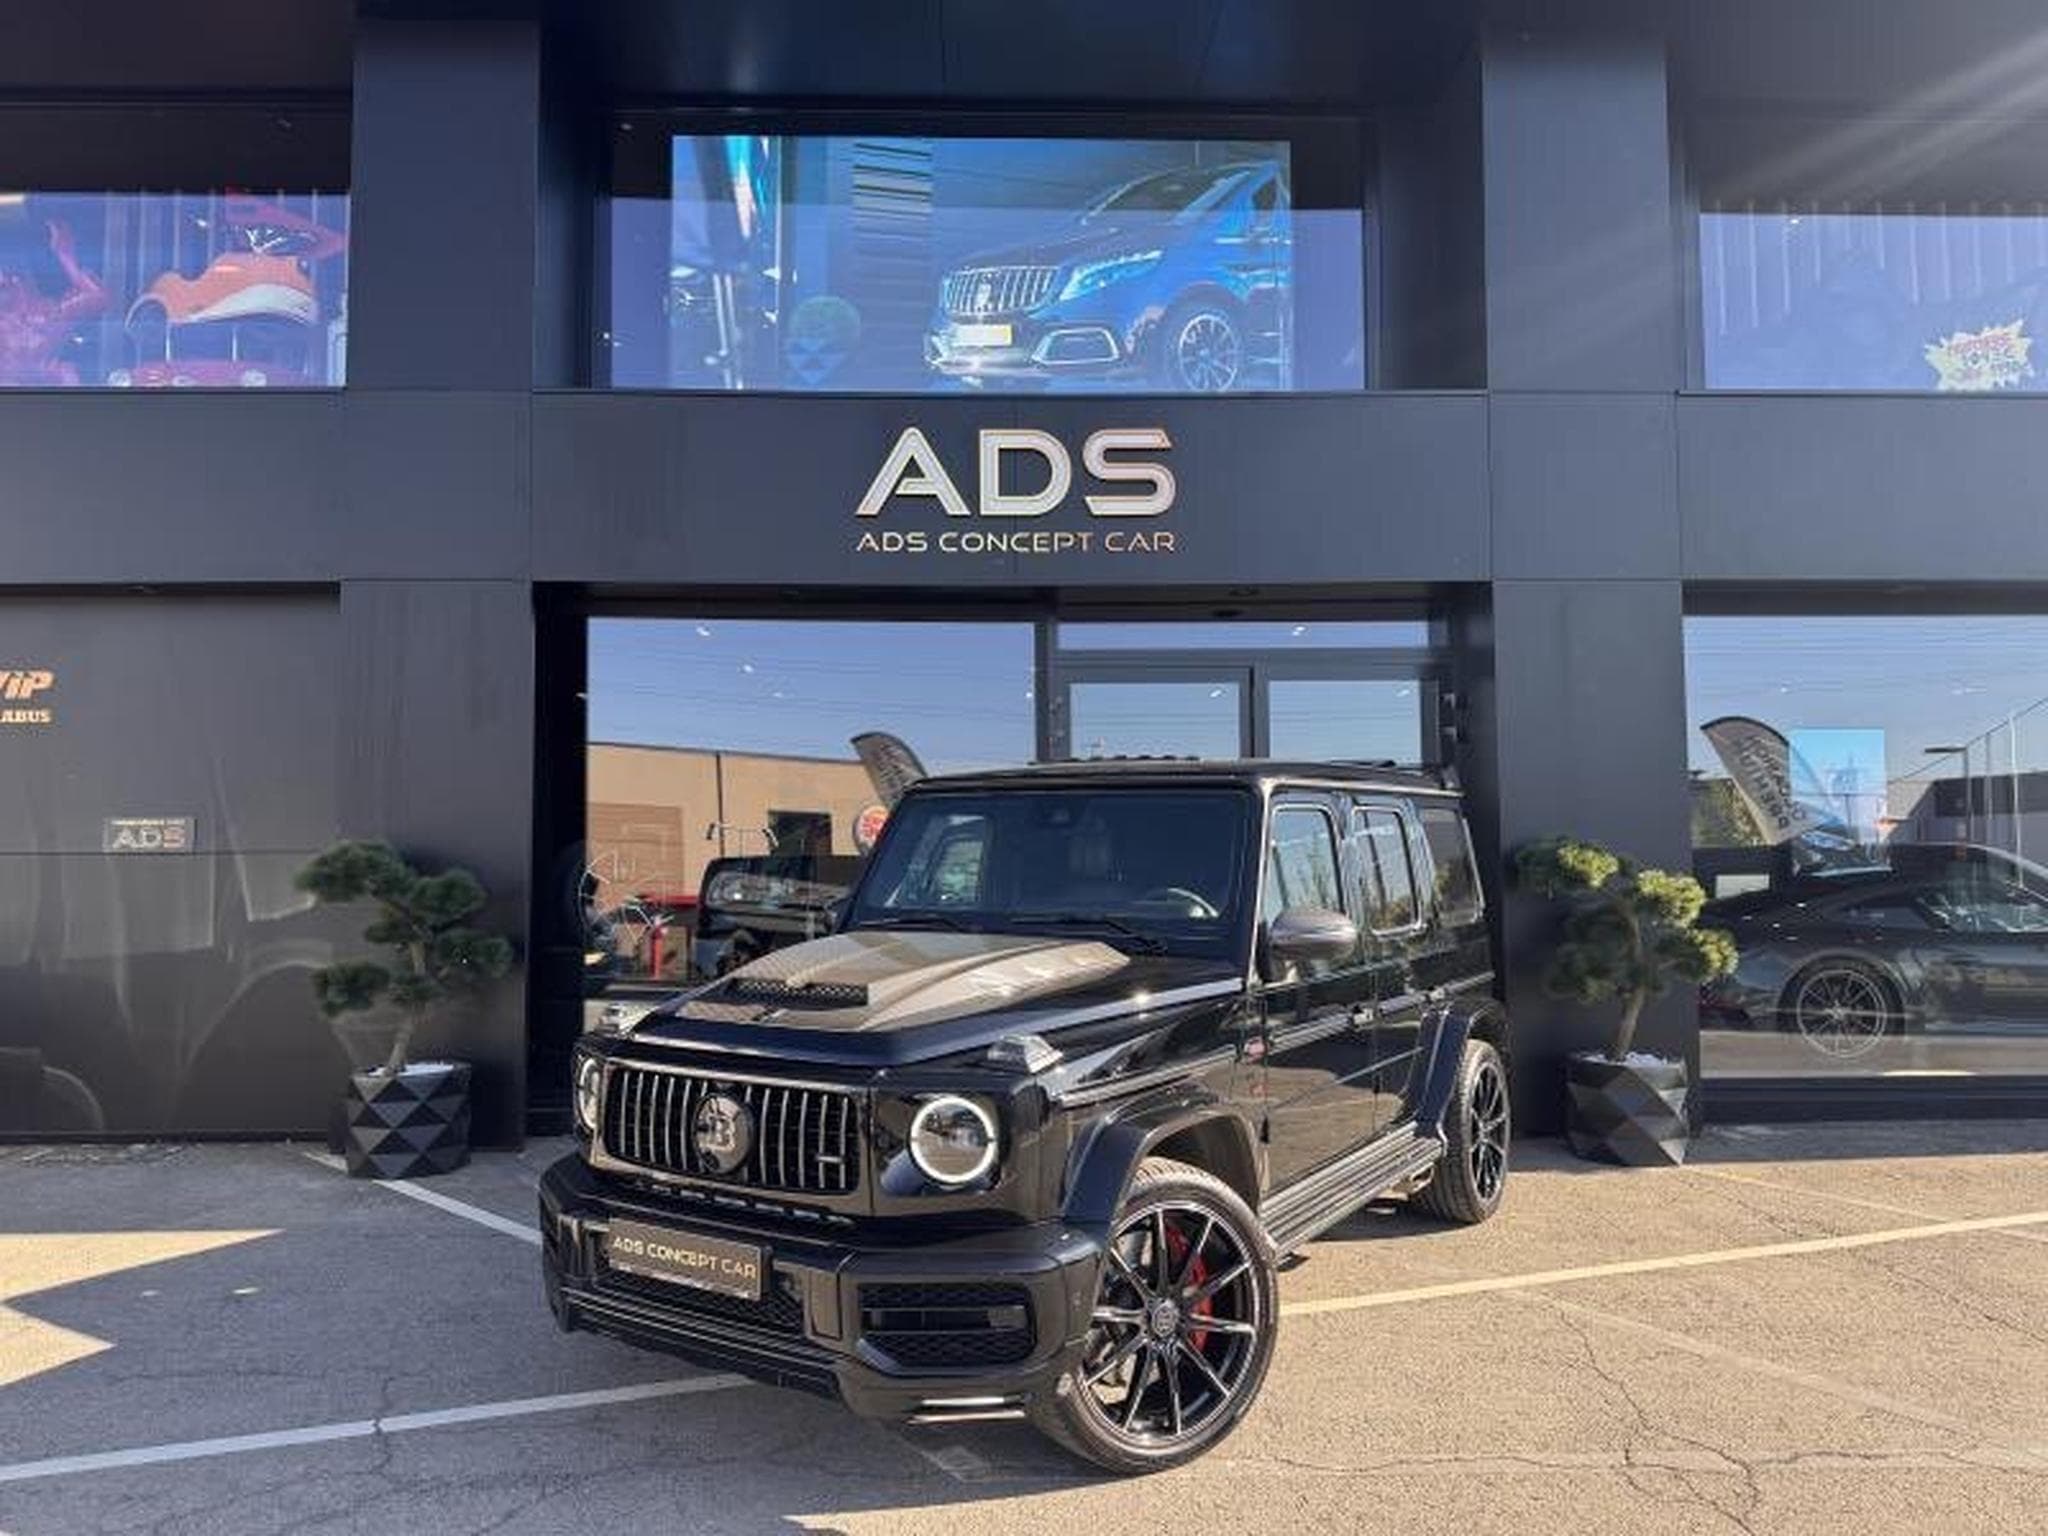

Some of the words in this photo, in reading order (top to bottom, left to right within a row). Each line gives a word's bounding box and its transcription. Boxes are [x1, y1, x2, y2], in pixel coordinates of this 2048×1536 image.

[855, 427, 1176, 516] ADS
[857, 532, 926, 552] ADS
[939, 532, 1092, 552] CONCEPT
[1105, 532, 1176, 552] CAR
[112, 828, 186, 849] ADS
[612, 1236, 644, 1256] ADS
[647, 1243, 719, 1271] CONCEPT
[720, 1258, 757, 1279] CAR
